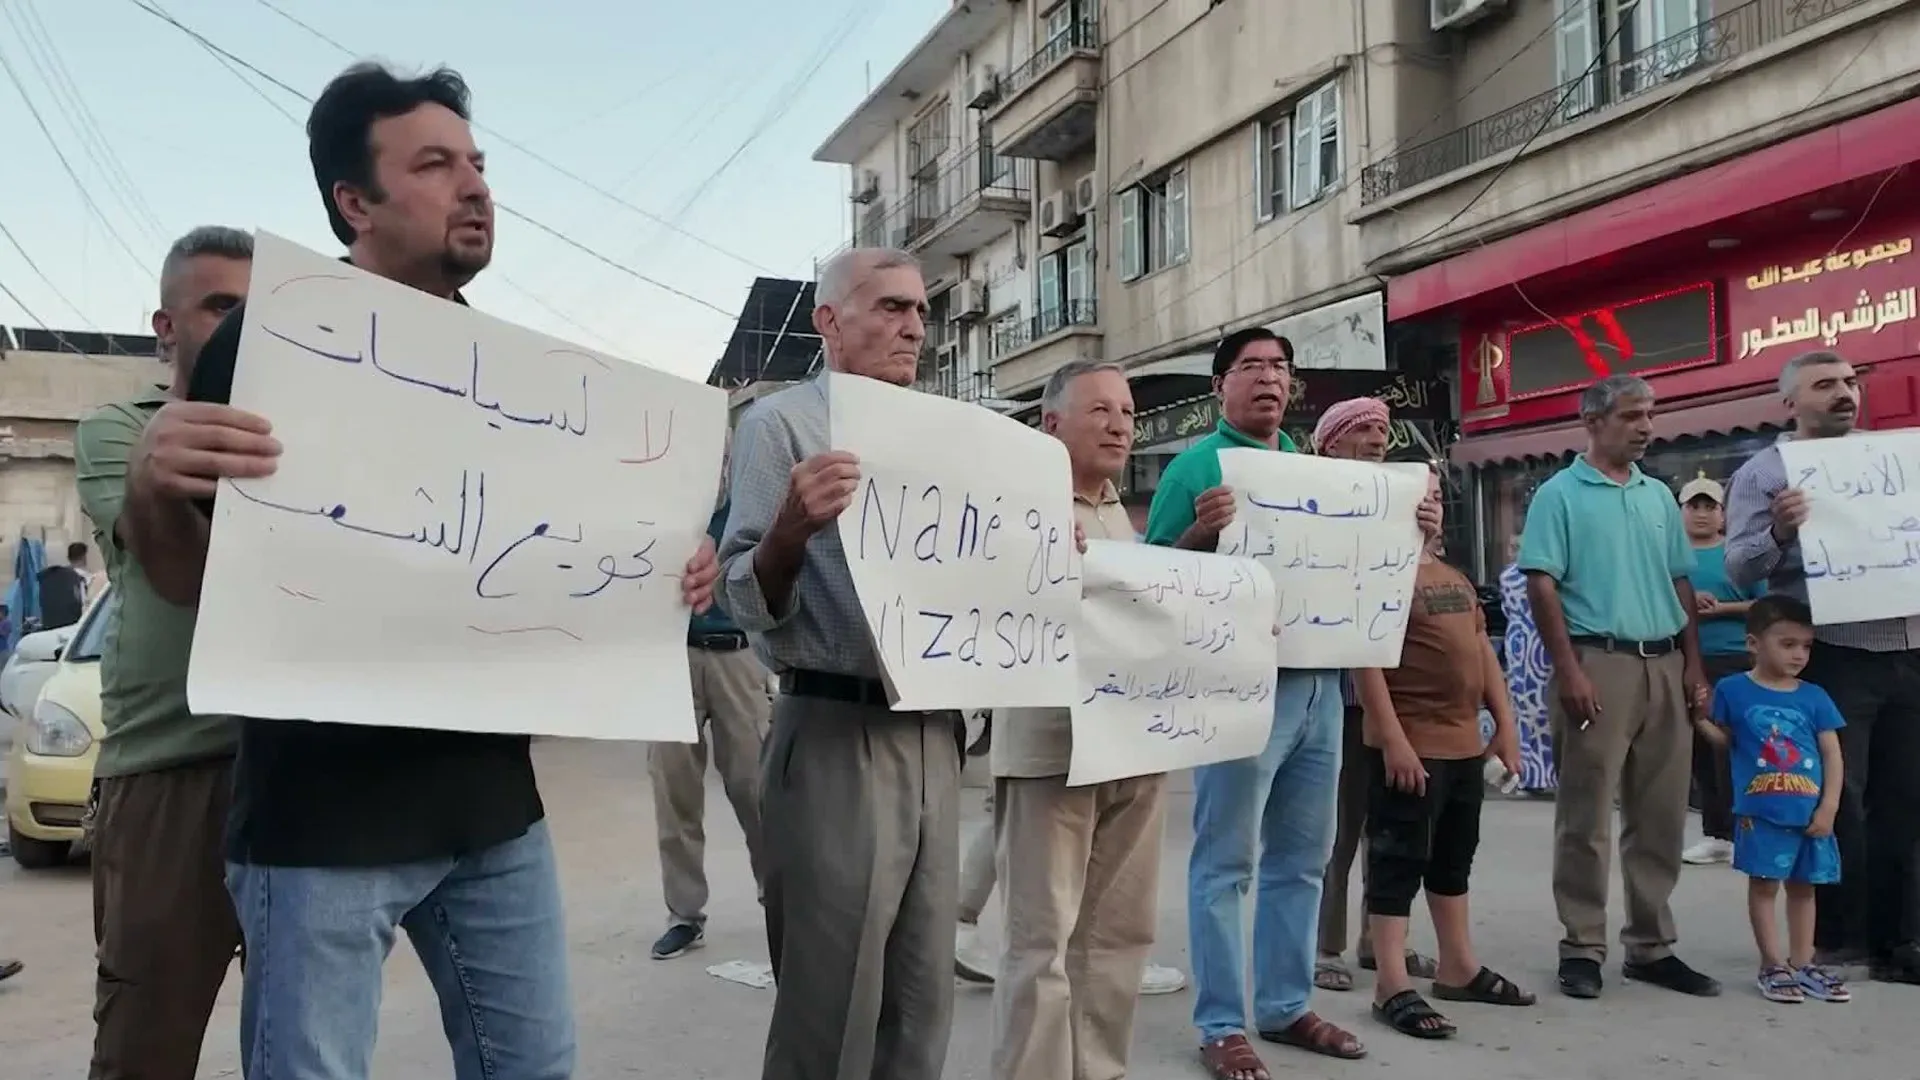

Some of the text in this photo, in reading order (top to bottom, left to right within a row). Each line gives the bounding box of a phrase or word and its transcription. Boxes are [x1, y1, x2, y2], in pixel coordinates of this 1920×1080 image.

[1825, 237, 1912, 270] مجموعة
[1738, 286, 1916, 359] القرشي للعطور
[261, 311, 673, 464] لا لسياسات
[229, 469, 657, 598] تجويع الشعب
[1246, 473, 1390, 522] الشعب
